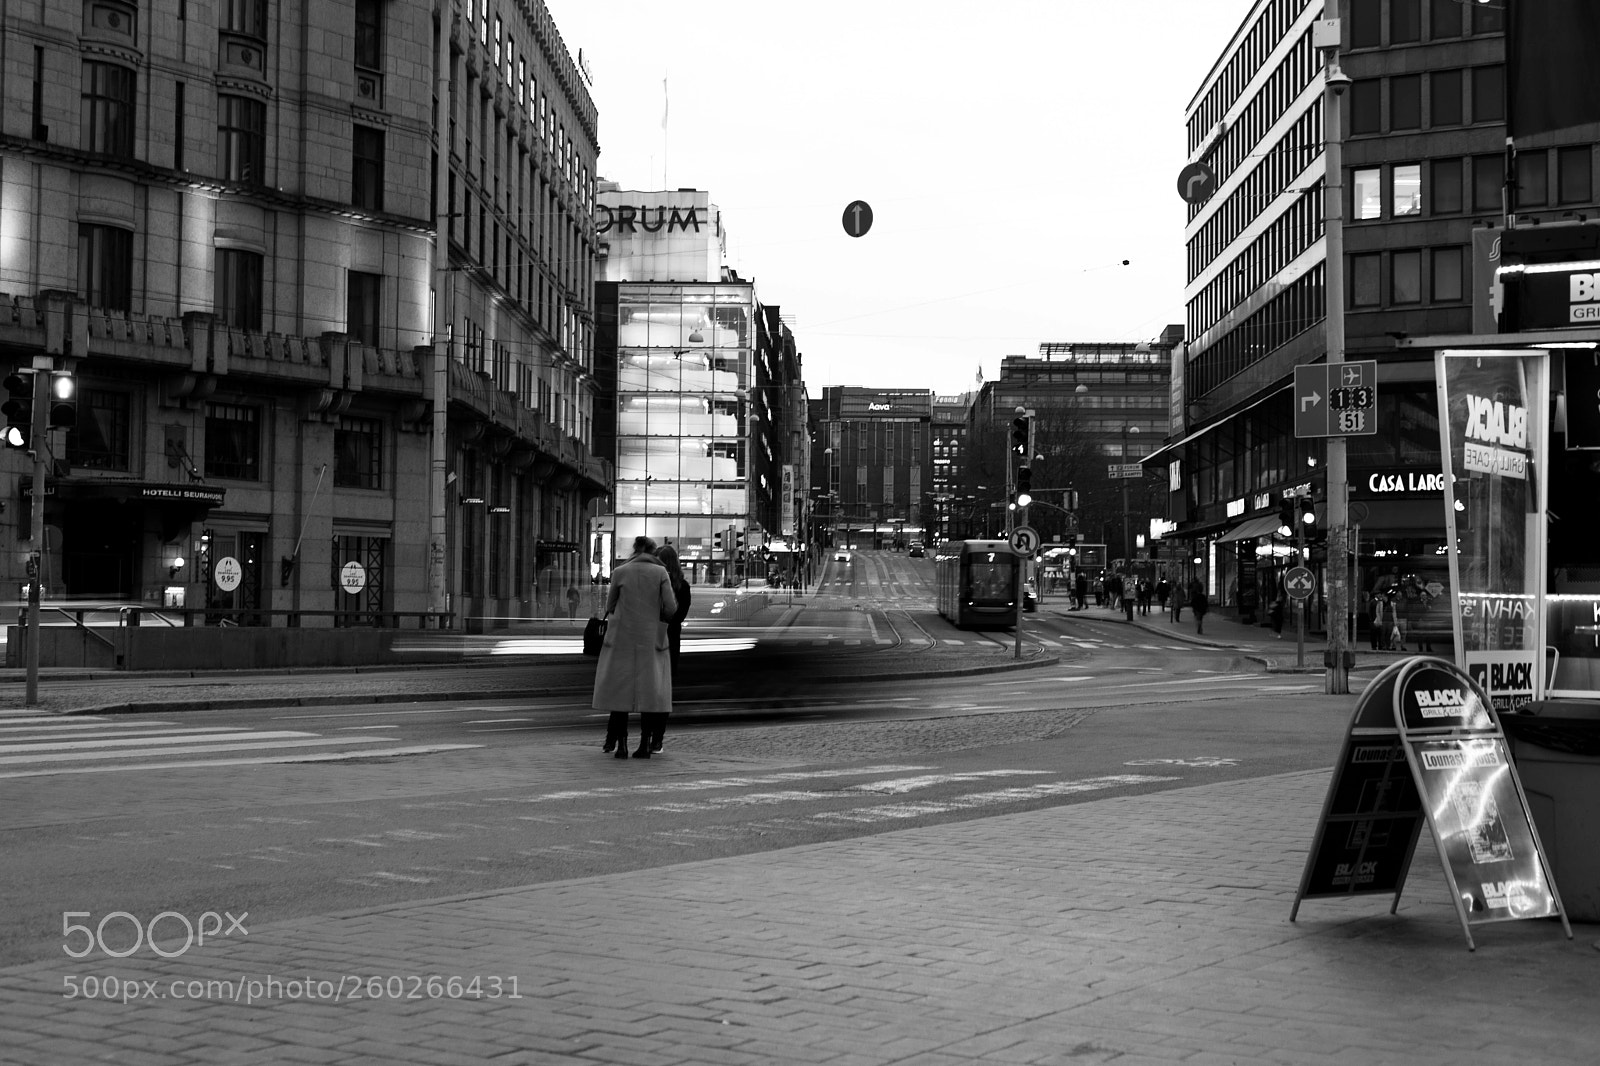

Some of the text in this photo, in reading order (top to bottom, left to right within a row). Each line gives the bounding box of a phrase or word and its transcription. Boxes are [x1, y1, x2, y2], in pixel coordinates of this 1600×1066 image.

[868, 401, 890, 411] Aava
[1337, 390, 1367, 407] 1 3
[1343, 413, 1360, 430] 51
[1368, 473, 1405, 492] CASA
[142, 489, 182, 497] HOTELLI
[987, 552, 996, 562] 7
[1490, 662, 1533, 691] BLACK
[1414, 689, 1466, 706] BLACK
[1492, 697, 1510, 709] GRILL
